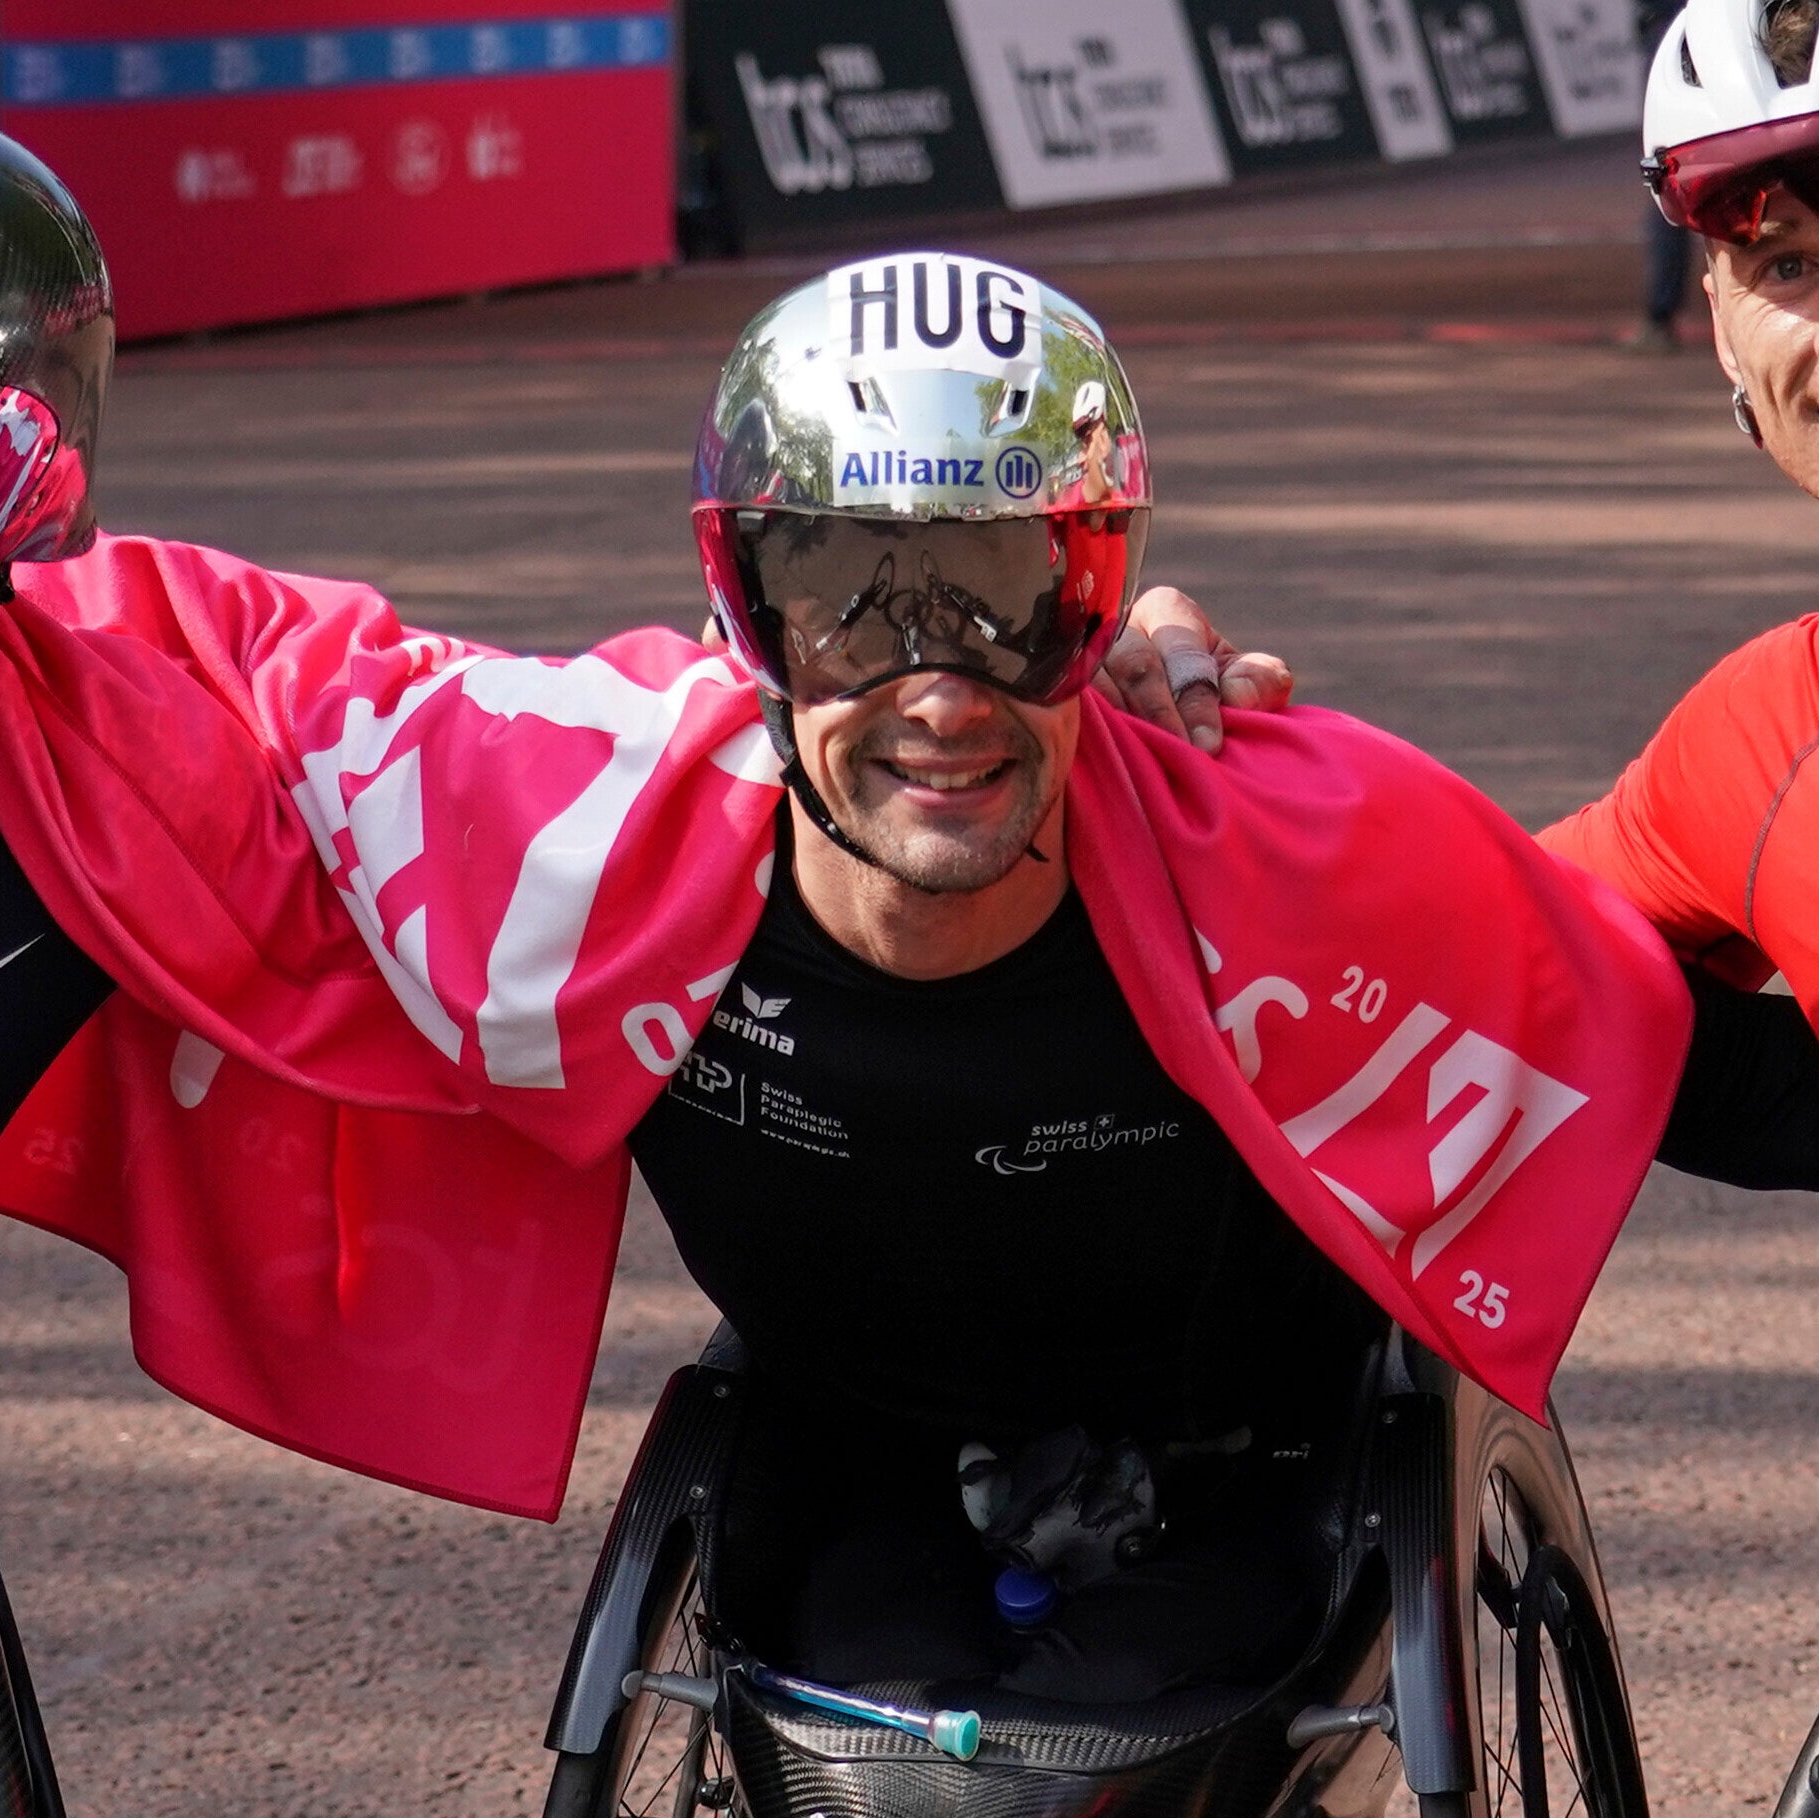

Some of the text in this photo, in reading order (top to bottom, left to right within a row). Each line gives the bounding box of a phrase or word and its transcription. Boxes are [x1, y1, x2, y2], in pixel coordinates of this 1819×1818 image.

[735, 50, 854, 194] tcs
[849, 262, 1026, 359] HUG
[839, 449, 985, 488] Allianz
[1330, 965, 1388, 1024] 20
[712, 1010, 796, 1056] erima
[760, 1081, 804, 1106] Swiss
[760, 1094, 843, 1128] Paraplegic
[760, 1106, 850, 1140] Foundation
[1023, 1121, 1180, 1156] paralympic
[1031, 1120, 1088, 1137] swiss
[1452, 1269, 1511, 1330] 25
